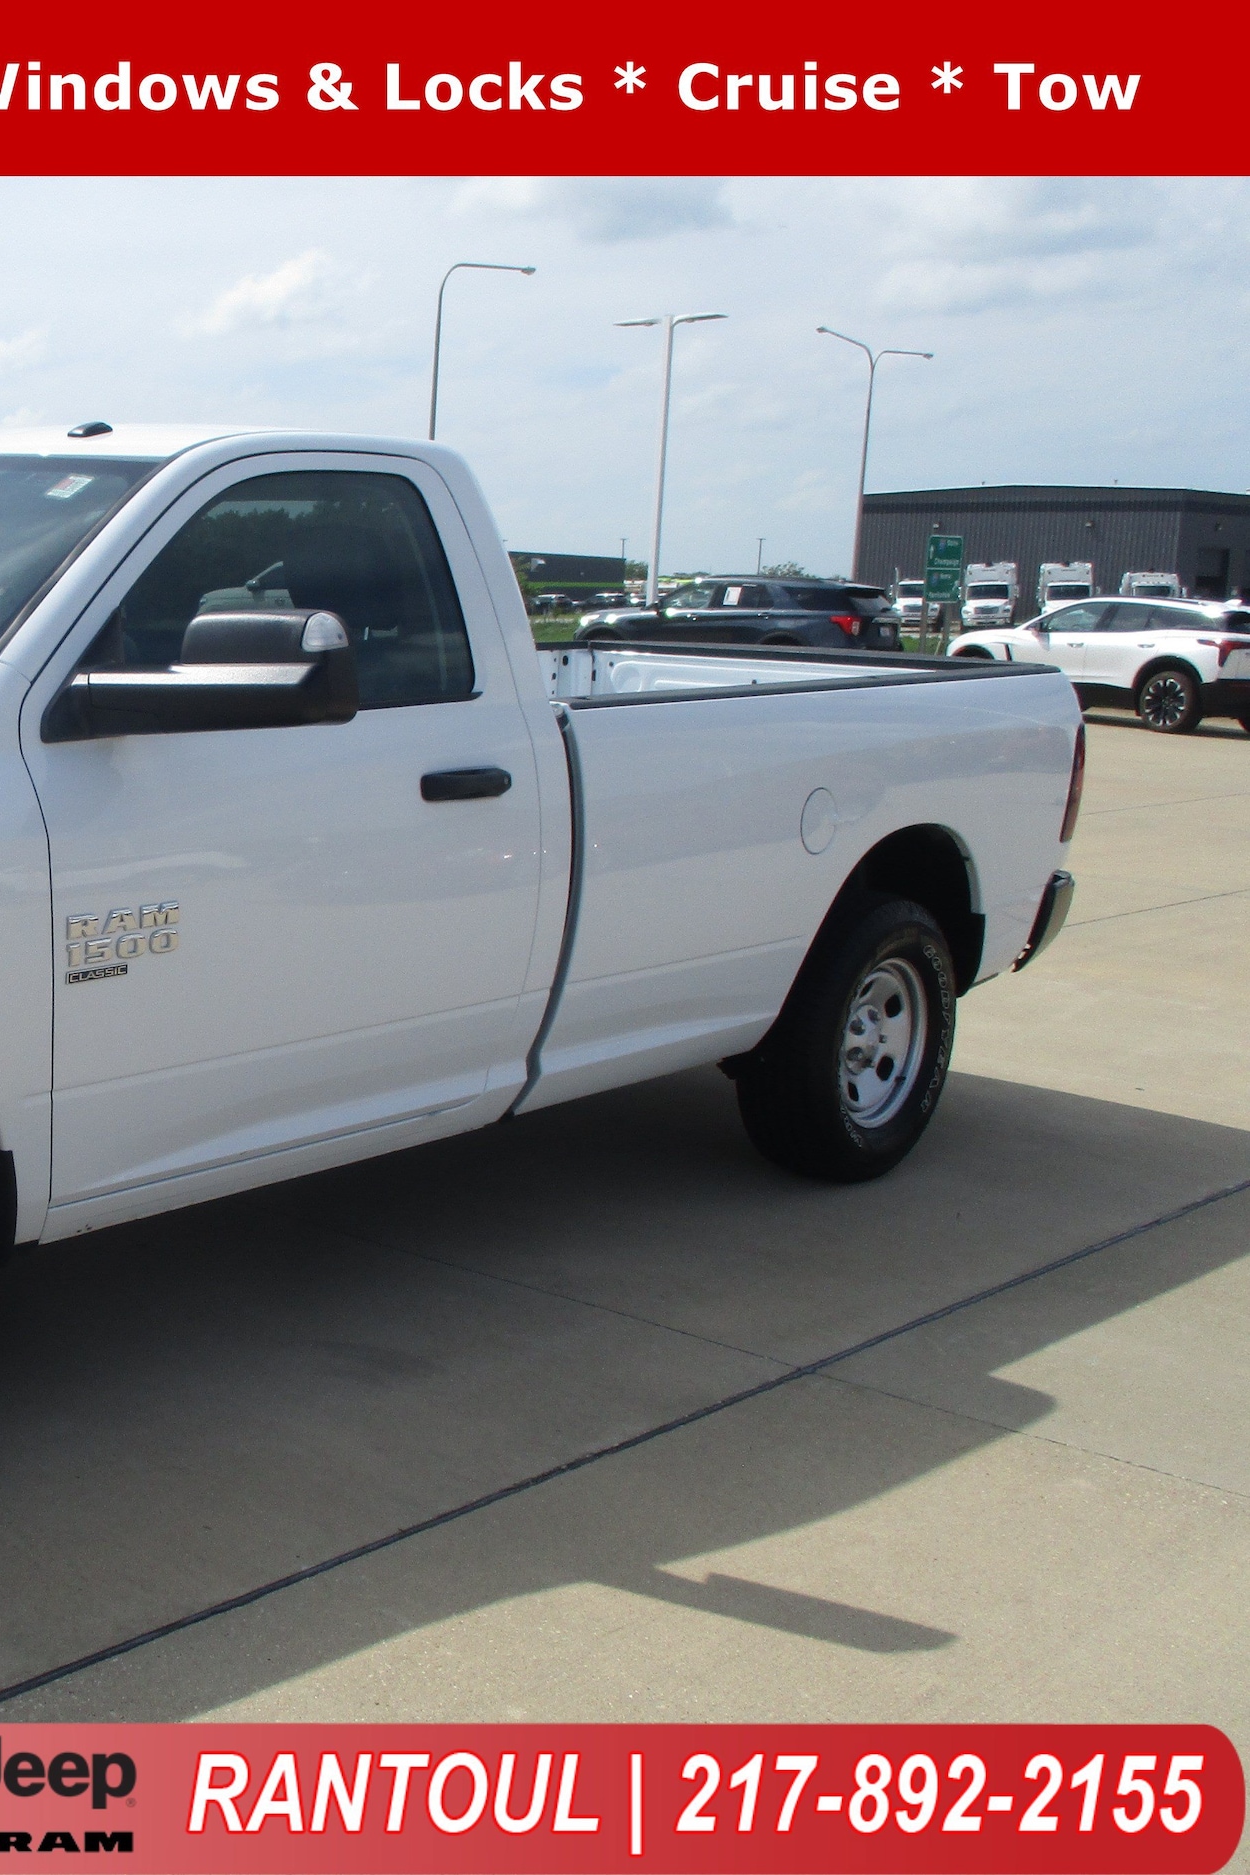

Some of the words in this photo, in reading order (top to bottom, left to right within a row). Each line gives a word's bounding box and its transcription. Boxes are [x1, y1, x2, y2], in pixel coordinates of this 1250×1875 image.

[66, 899, 180, 940] RAM
[66, 927, 180, 968] 1500
[68, 964, 128, 984] CLASSIC
